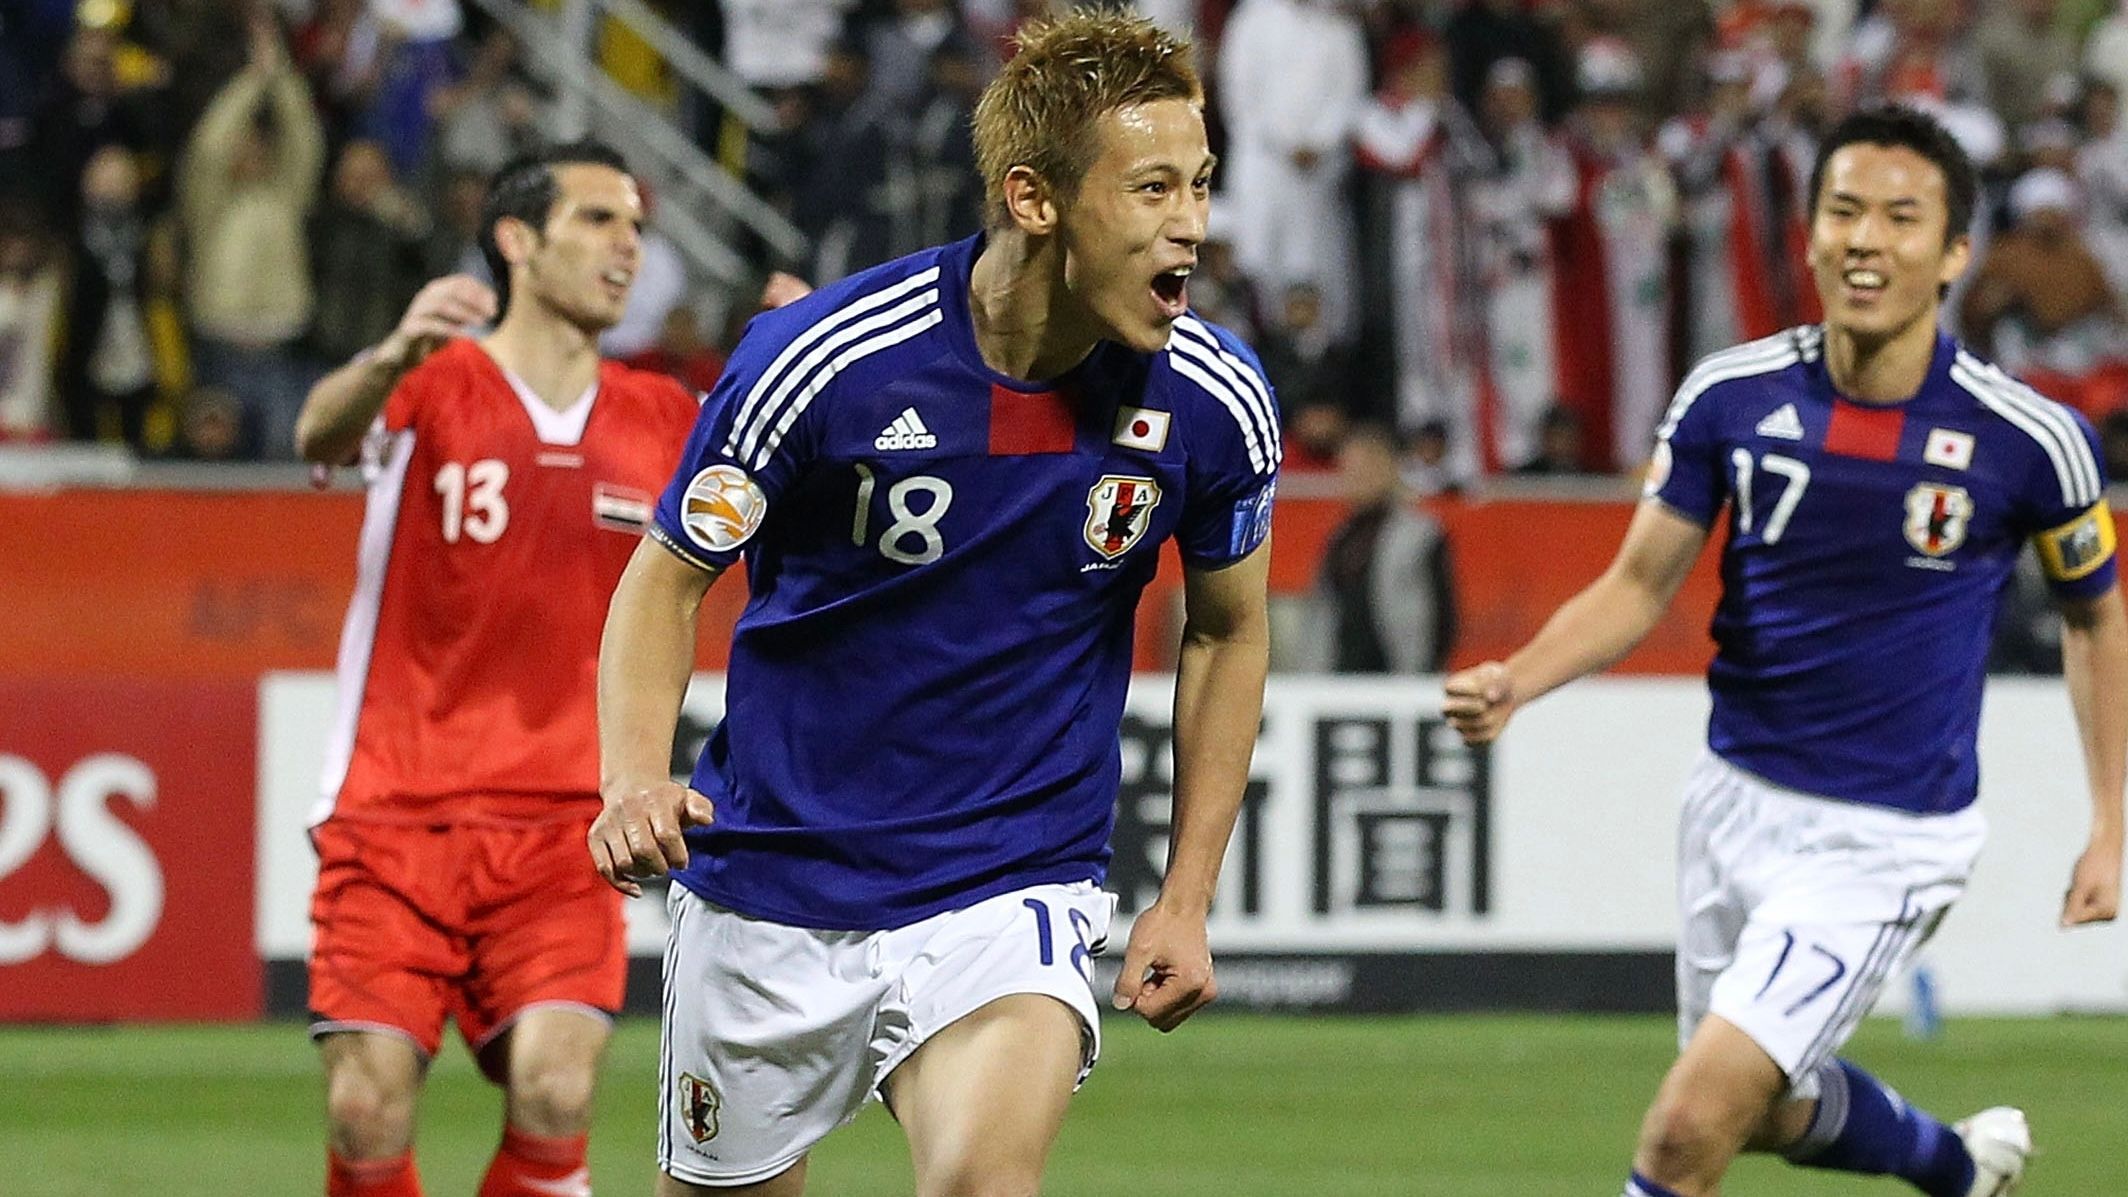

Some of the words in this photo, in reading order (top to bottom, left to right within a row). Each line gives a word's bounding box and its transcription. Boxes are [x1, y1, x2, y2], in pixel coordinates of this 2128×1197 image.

[874, 433, 938, 450] adidas
[434, 458, 510, 543] 13
[852, 463, 953, 565] 18
[1731, 447, 1811, 545] 17
[1755, 930, 1845, 1017] 17
